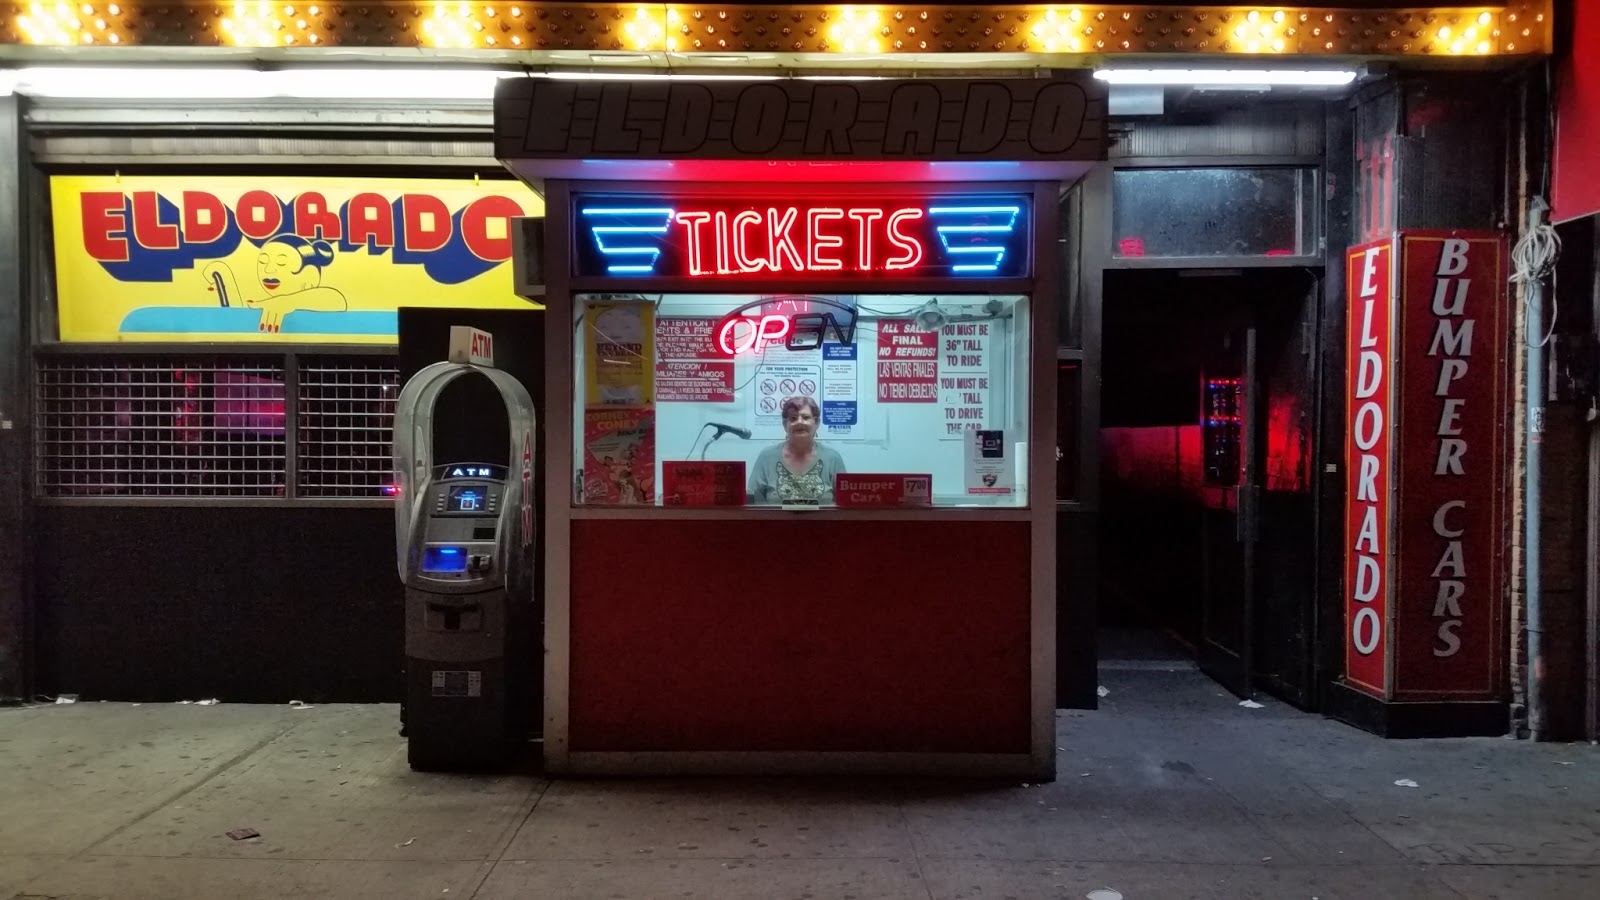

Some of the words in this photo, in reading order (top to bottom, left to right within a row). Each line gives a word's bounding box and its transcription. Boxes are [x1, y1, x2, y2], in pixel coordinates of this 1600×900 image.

[523, 82, 1088, 154] ELDORADO
[80, 189, 525, 263] ELDORADO
[676, 208, 923, 275] TICKETS
[719, 313, 857, 354] OPEN
[882, 324, 898, 333] ALL
[942, 325, 954, 336] YOU
[957, 325, 976, 336] MUST
[979, 325, 988, 336] BE
[472, 332, 491, 359] ATM
[892, 336, 923, 345] FINAL
[963, 340, 982, 351] TALL
[879, 347, 891, 356] NO
[896, 348, 936, 356] REFUNDS!
[1427, 238, 1476, 475] BUMPER
[946, 355, 958, 366] TO
[961, 355, 982, 366] RIDE
[880, 362, 889, 378] LAS
[891, 362, 911, 378] VENTAS
[913, 362, 934, 378] FINALES
[940, 378, 954, 389] YOU
[957, 378, 976, 389] MUST
[979, 378, 988, 389] BE
[879, 383, 887, 398] NO
[963, 393, 982, 404] TALL
[945, 408, 955, 419] TO
[958, 408, 983, 419] DRIVE
[1353, 247, 1383, 654] ELDORADO
[453, 468, 490, 476] ATM
[840, 480, 895, 492] Bumper
[851, 492, 881, 502] Cars
[1430, 500, 1467, 657] CARS
